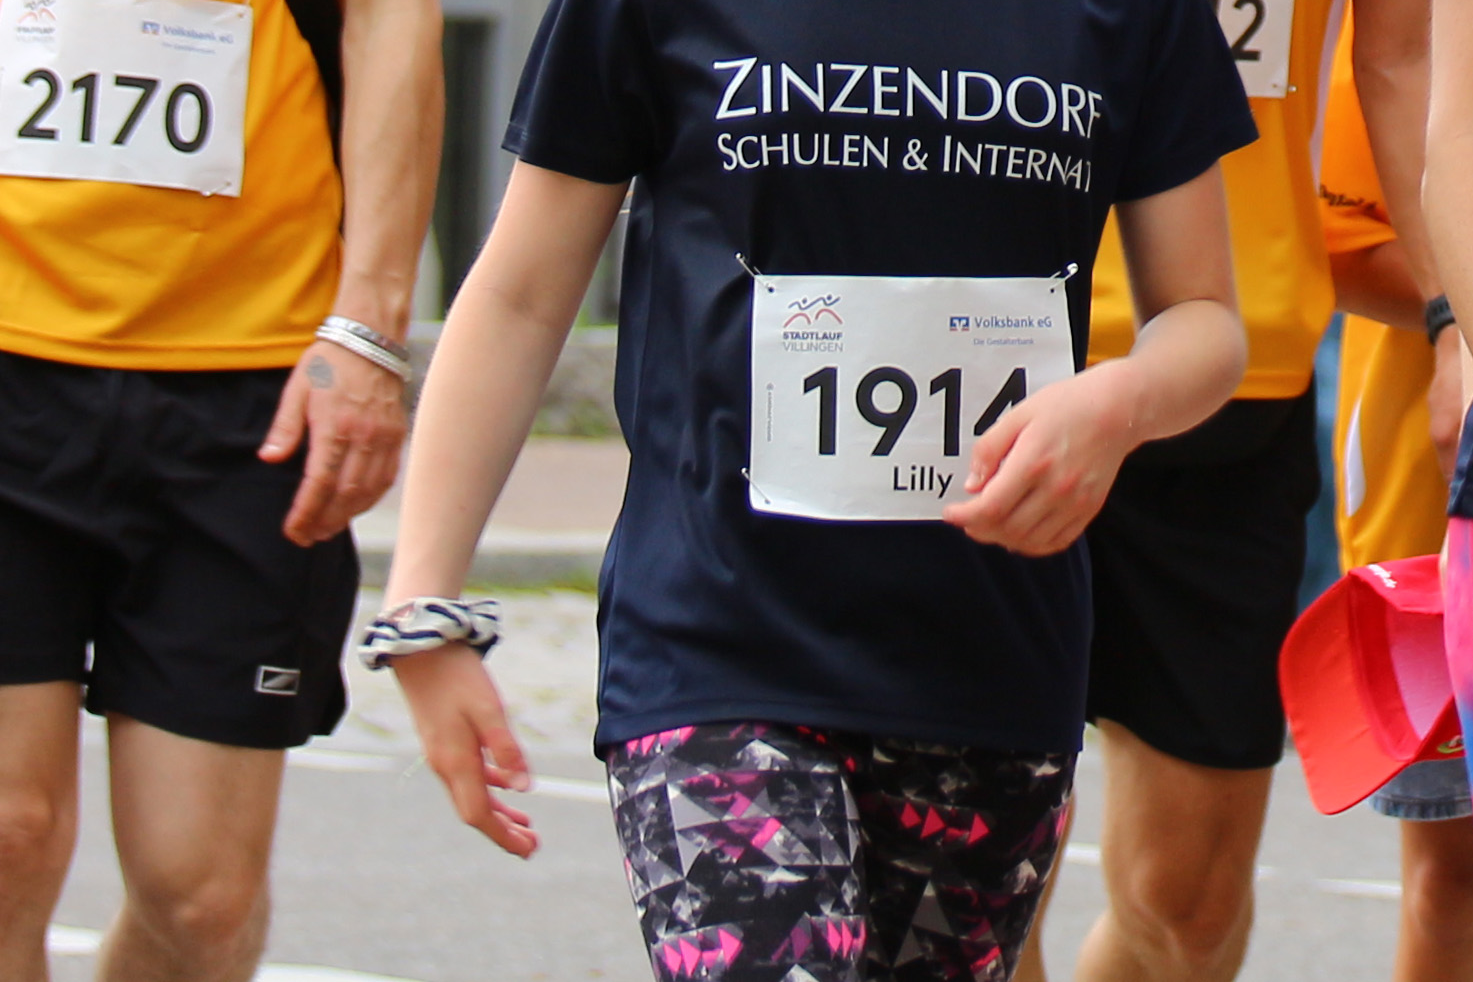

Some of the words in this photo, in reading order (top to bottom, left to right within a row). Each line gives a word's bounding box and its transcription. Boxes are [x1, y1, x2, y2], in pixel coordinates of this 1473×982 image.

[17, 68, 213, 154] 2170
[713, 56, 1103, 139] ZINZENDORF
[716, 132, 890, 171] SCHULEN
[902, 138, 928, 171] &
[943, 135, 1091, 192] INTERNAT
[783, 331, 843, 341] STADTLAUF
[974, 316, 1035, 329] Volksbank
[1037, 316, 1052, 328] eG
[782, 341, 844, 353] VILLINGEN
[892, 465, 954, 500] Lilly
